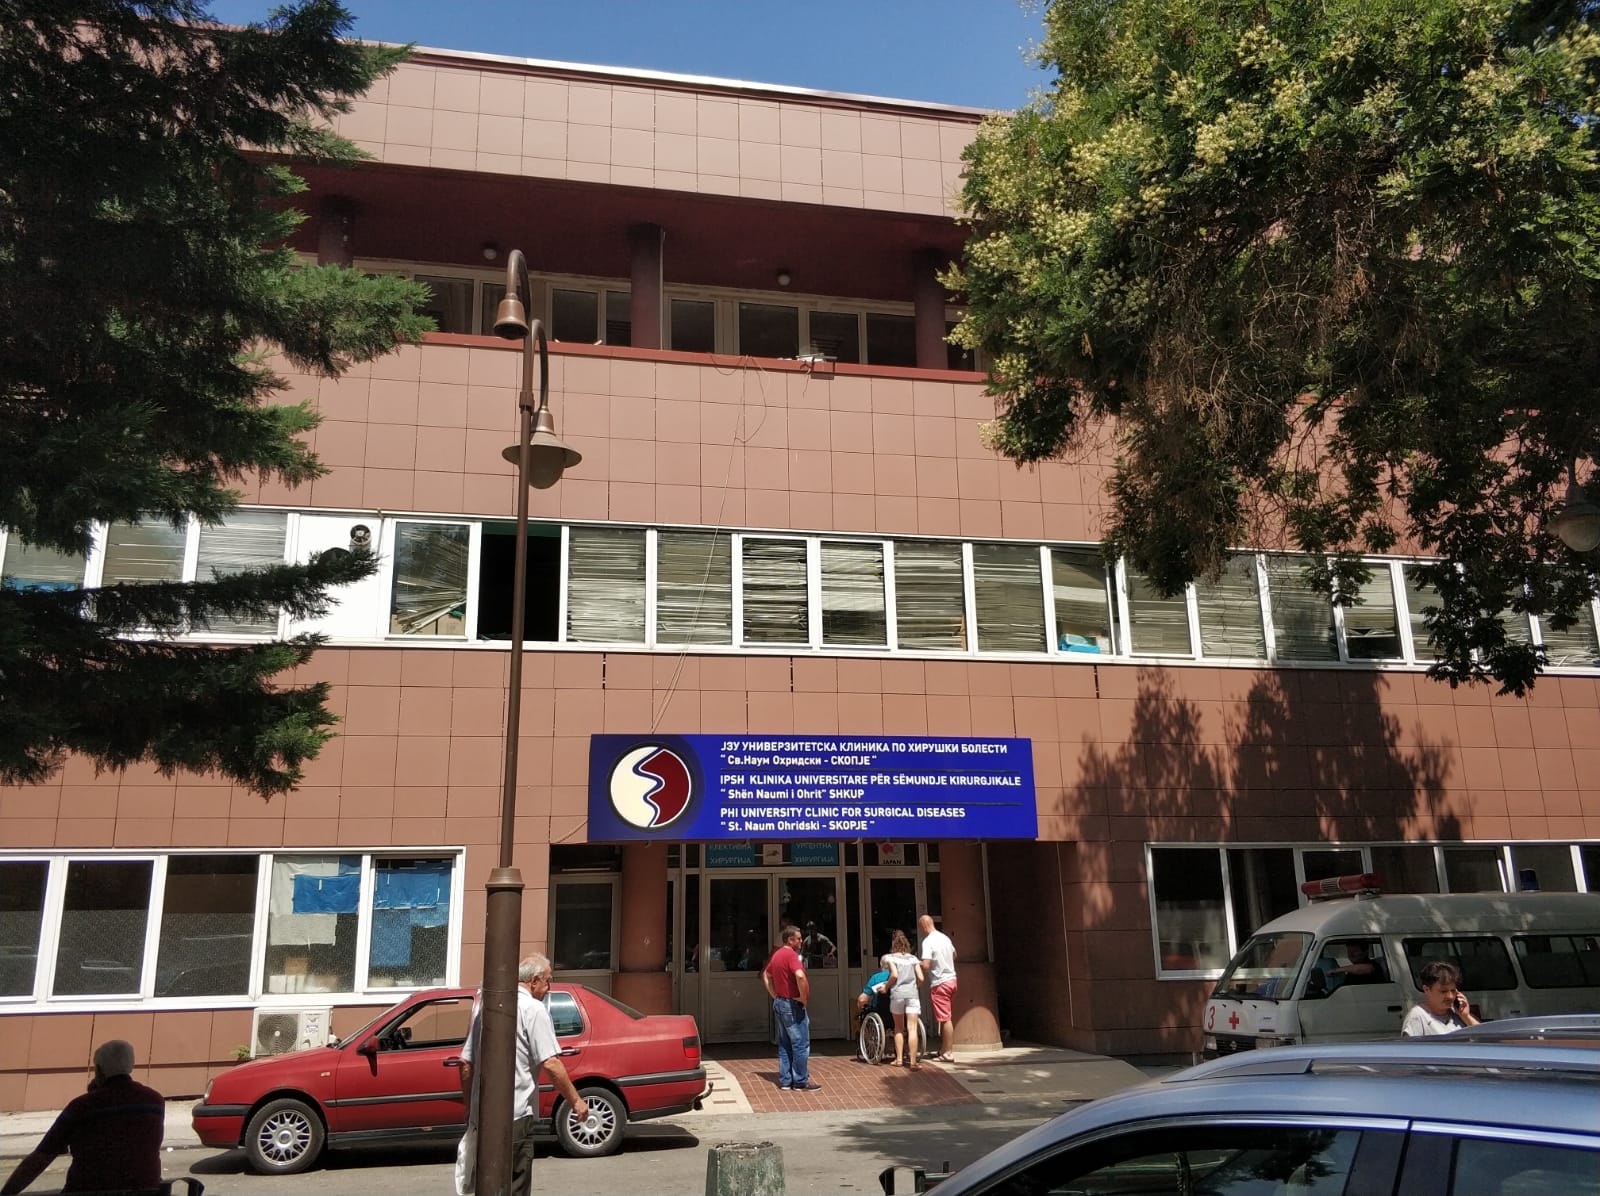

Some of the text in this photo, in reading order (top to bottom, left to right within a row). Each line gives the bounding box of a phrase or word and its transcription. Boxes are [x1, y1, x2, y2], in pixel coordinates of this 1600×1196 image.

[720, 741, 1008, 754] ЈЗУ УНИВЕРЗИТЕТСКА КЛИНИКА ПО ХИРУШКИ БОЛЕСТИ
[772, 755, 822, 767] Охридски
[830, 756, 871, 766] СКОПЈЕ
[720, 773, 1022, 786] IPSH KLINIKA UNIVERSITARE PËR SËMUNDJE KIRURGJIKALE
[756, 789, 789, 799] Naumi
[791, 789, 795, 799] i
[829, 789, 865, 799] SHKUP
[720, 807, 966, 818] PHI UNIVERSITY CLINIC FOR SURGICAL DISEASES
[745, 821, 775, 831] Naum
[777, 821, 820, 831] Ohridski
[829, 821, 868, 831] SKOPJE
[1208, 1006, 1216, 1031] 3
